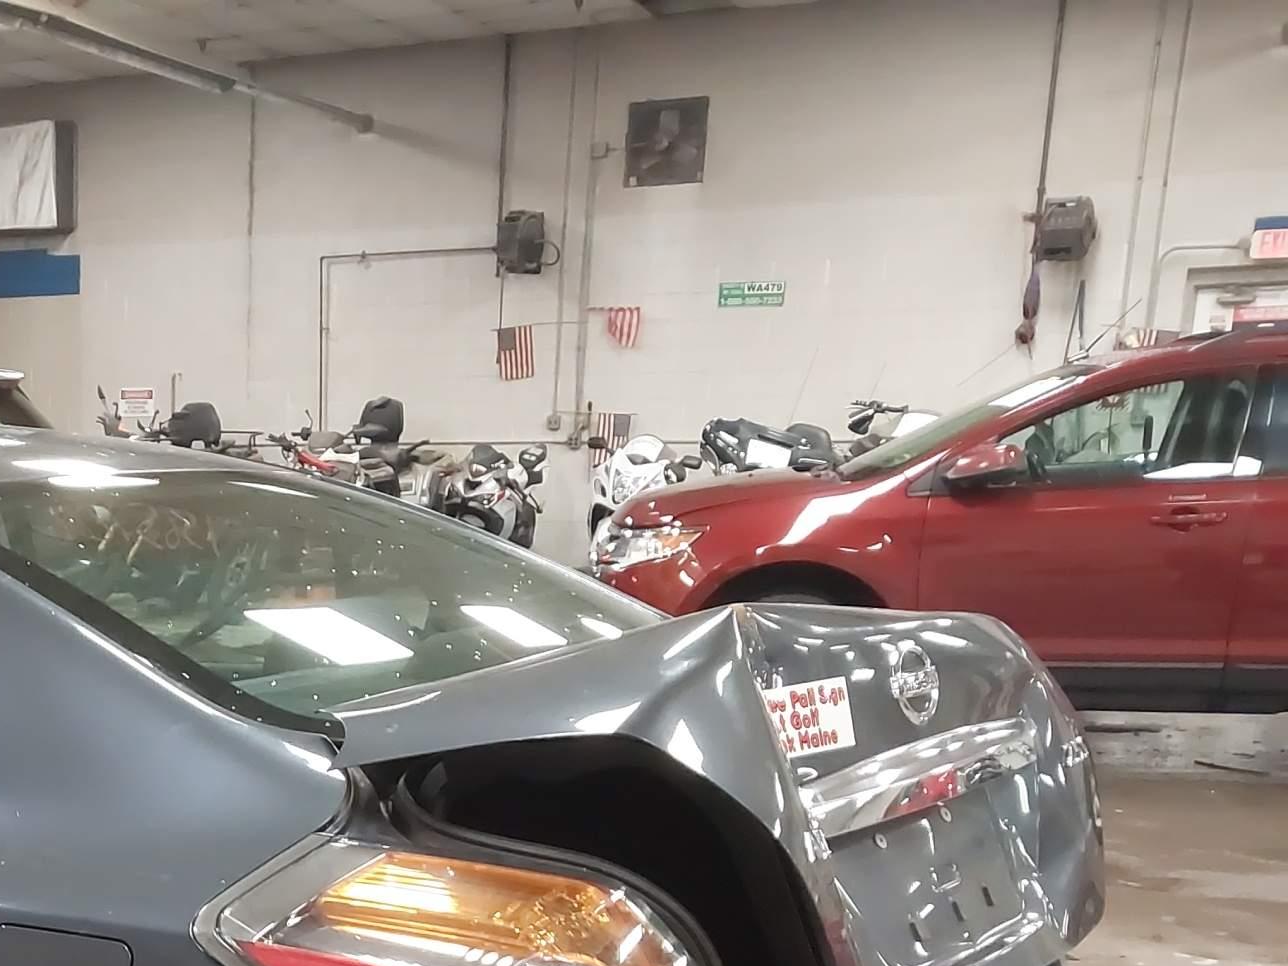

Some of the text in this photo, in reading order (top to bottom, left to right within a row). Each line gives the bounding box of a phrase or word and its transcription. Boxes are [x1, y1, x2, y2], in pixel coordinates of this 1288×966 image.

[817, 685, 845, 706] Sign
[790, 707, 819, 730] Golf
[798, 727, 838, 750] Maine
